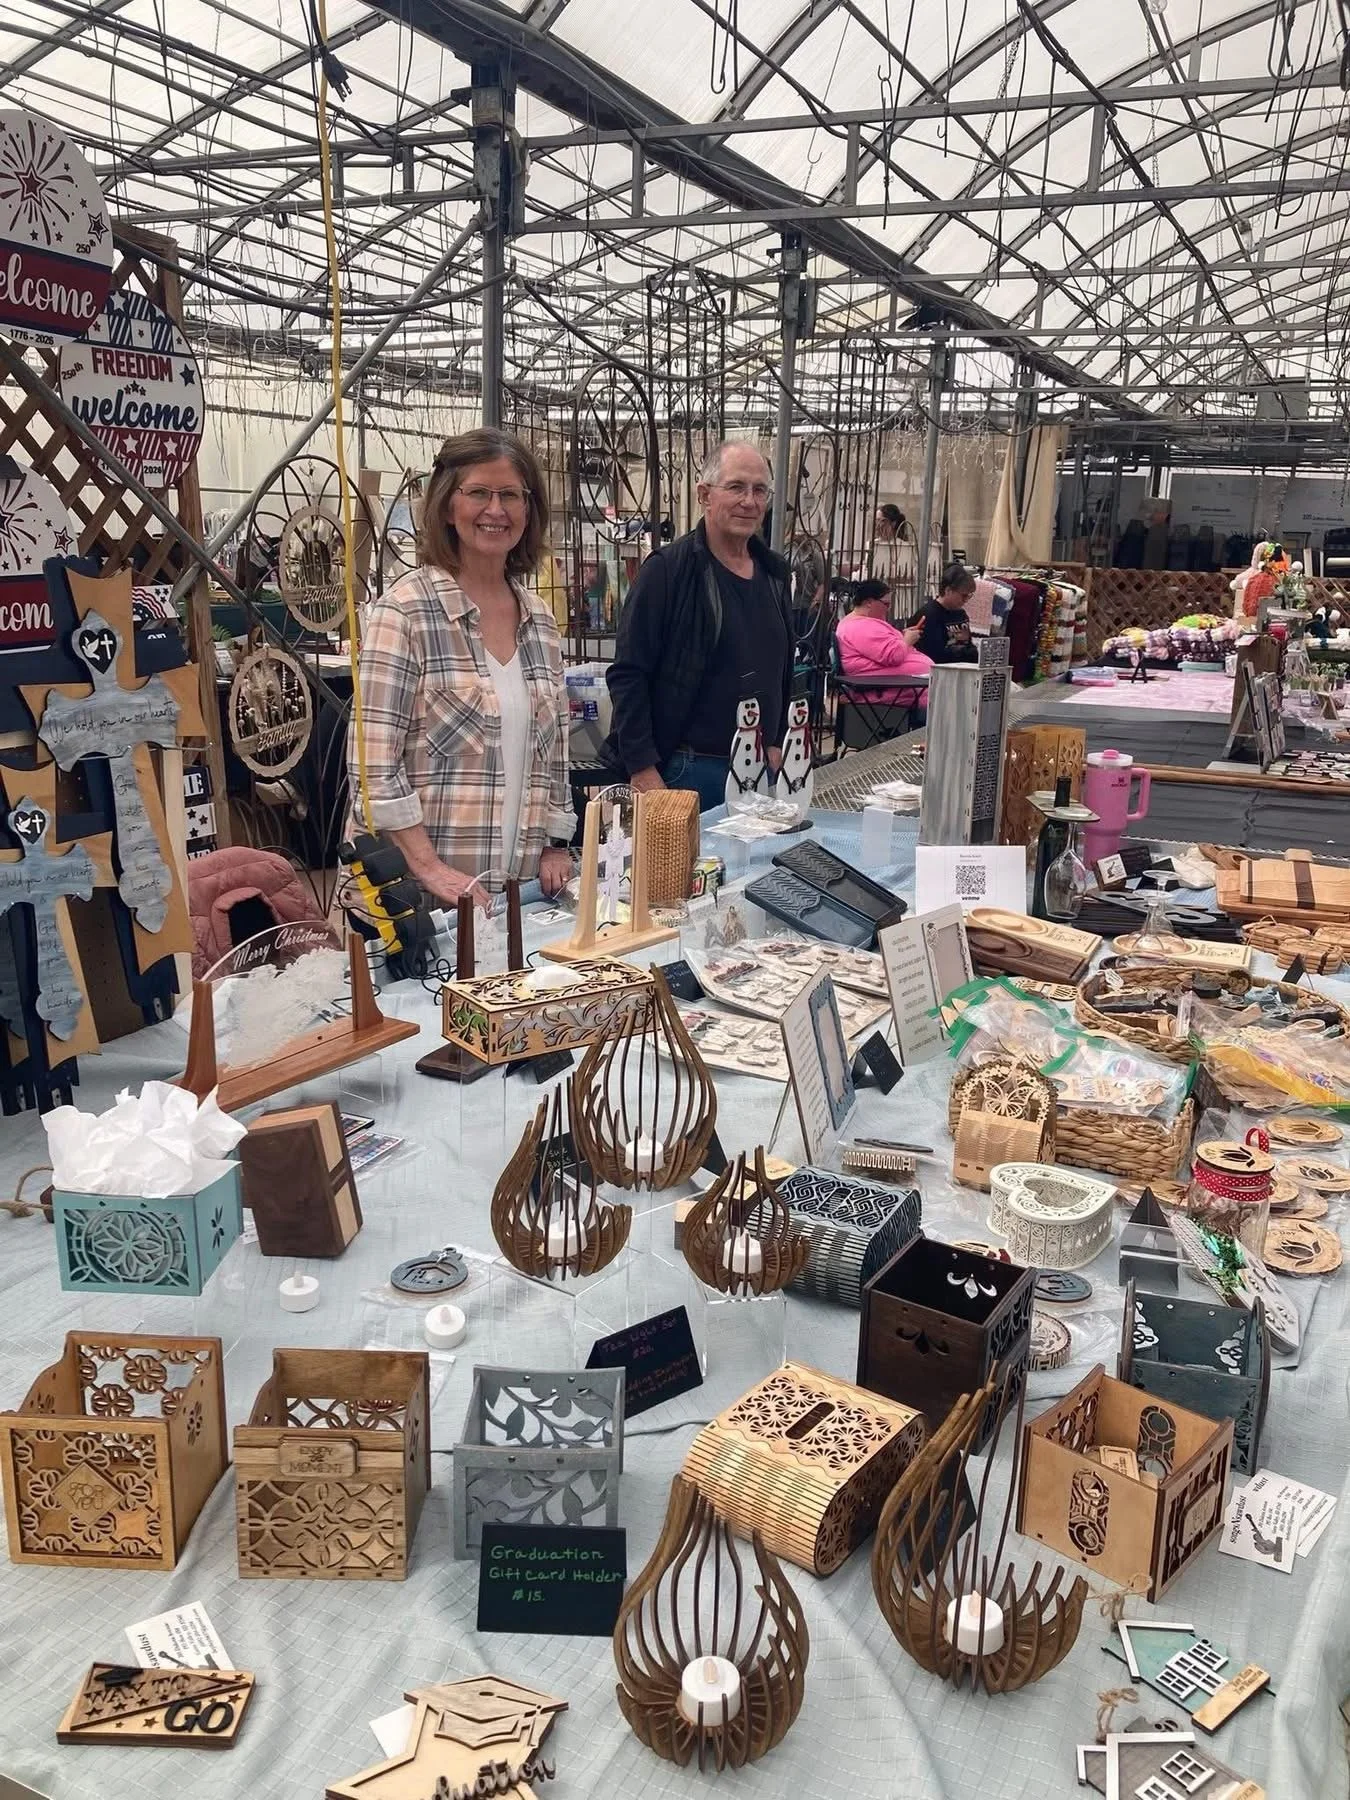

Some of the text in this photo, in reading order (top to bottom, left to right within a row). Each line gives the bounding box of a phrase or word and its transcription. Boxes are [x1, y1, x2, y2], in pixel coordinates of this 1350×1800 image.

[61, 362, 84, 380] 250th
[91, 347, 173, 382] FREEDOM
[72, 389, 199, 432] welcome
[143, 465, 163, 475] 2026
[233, 927, 329, 971] Merry Christmas
[289, 1461, 344, 1474] MOMENT
[490, 1545, 604, 1561] Graduation
[489, 1566, 520, 1580] Gift
[573, 1569, 622, 1583] Holder
[83, 1673, 192, 1704] WAY TO
[164, 1700, 234, 1734] GO
